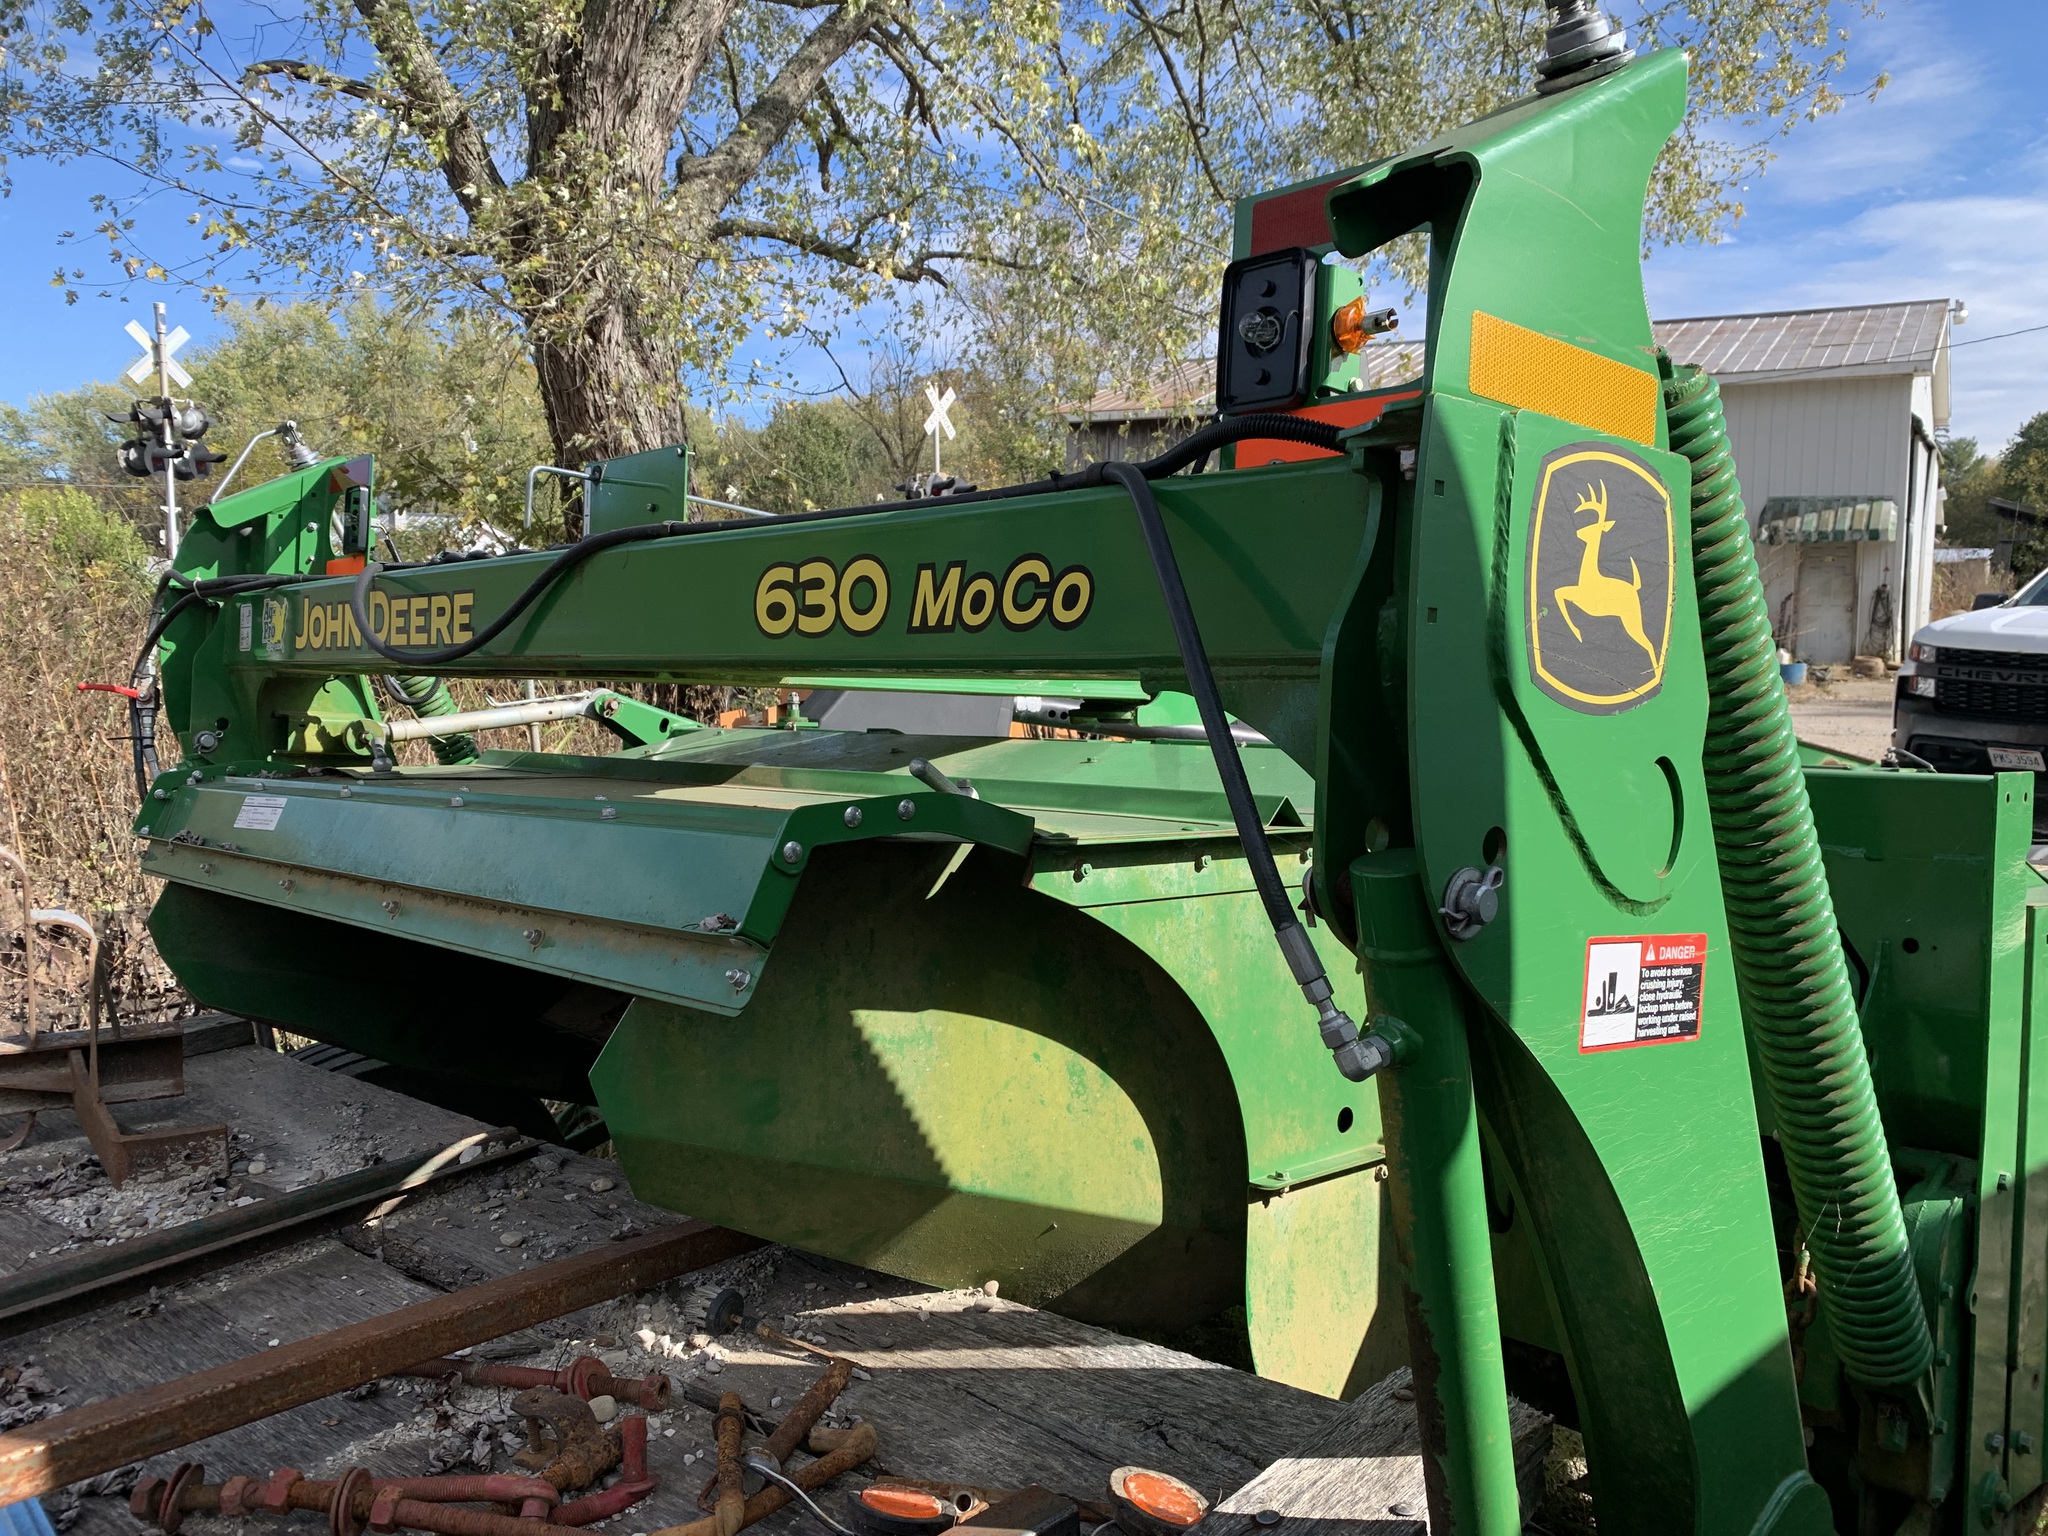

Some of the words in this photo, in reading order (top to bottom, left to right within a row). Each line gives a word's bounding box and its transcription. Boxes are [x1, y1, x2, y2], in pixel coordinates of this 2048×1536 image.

[754, 553, 891, 640] 630
[906, 552, 1095, 634] MoCo
[295, 597, 362, 650] JOHN
[369, 590, 473, 646] DEERE
[1992, 753, 2013, 764] PKS
[1659, 946, 1695, 960] DANGER
[1641, 968, 1649, 978] To
[1650, 967, 1666, 978] avoid
[1672, 966, 1692, 976] serious
[1640, 979, 1666, 991] crushing
[1666, 978, 1684, 989] injury,
[1639, 992, 1656, 1002] close
[1656, 990, 1682, 1002] hydraulic
[1639, 1003, 1658, 1014] lockup
[1659, 1002, 1674, 1011] valve
[1675, 1000, 1693, 1010] before
[1637, 1015, 1661, 1026] working
[1661, 1013, 1678, 1023] under
[1679, 1011, 1697, 1021] raised
[1637, 1027, 1667, 1037] harvesting
[1667, 1024, 1680, 1034] unit.
